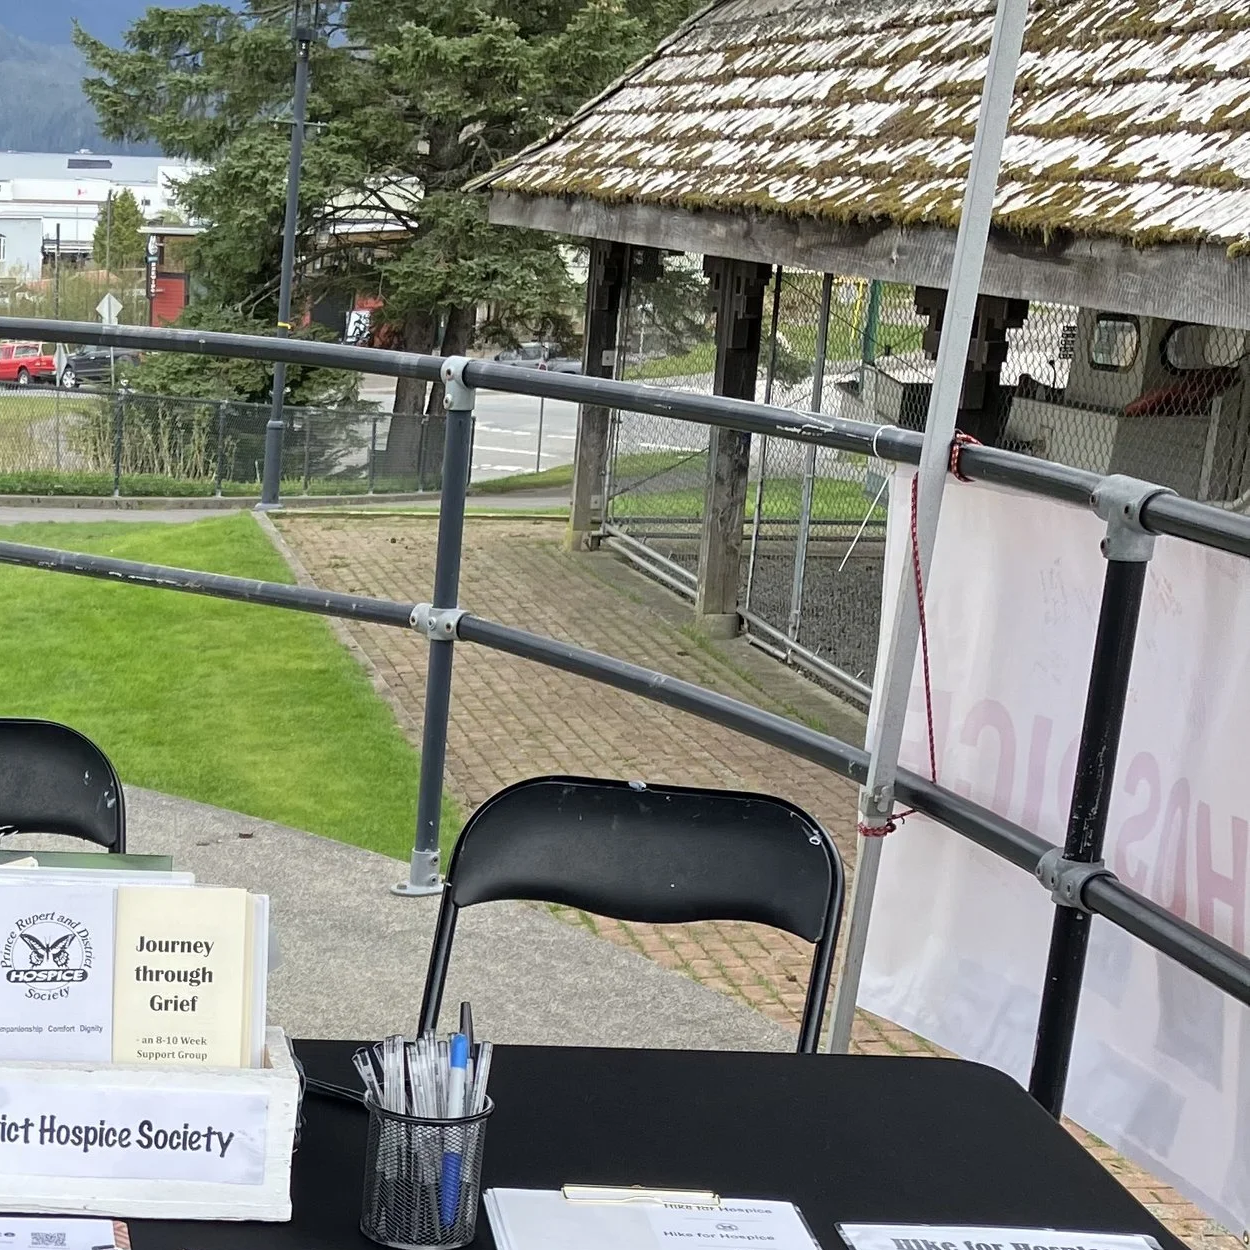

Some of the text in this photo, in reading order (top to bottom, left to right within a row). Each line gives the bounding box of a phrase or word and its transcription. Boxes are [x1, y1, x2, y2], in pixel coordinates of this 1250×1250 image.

[0, 912, 95, 968] Prince Rupert and District
[136, 936, 214, 957] Journey
[10, 970, 84, 982] HOSPICE
[135, 966, 213, 987] through
[25, 987, 69, 1000] Society
[150, 995, 198, 1012] Grief
[80, 1025, 103, 1033] Dignity
[156, 1036, 178, 1044] 8-10
[181, 1037, 207, 1045] Week
[137, 1050, 207, 1061] Support Group
[39, 1115, 131, 1153] Hospice
[136, 1120, 235, 1158] Society
